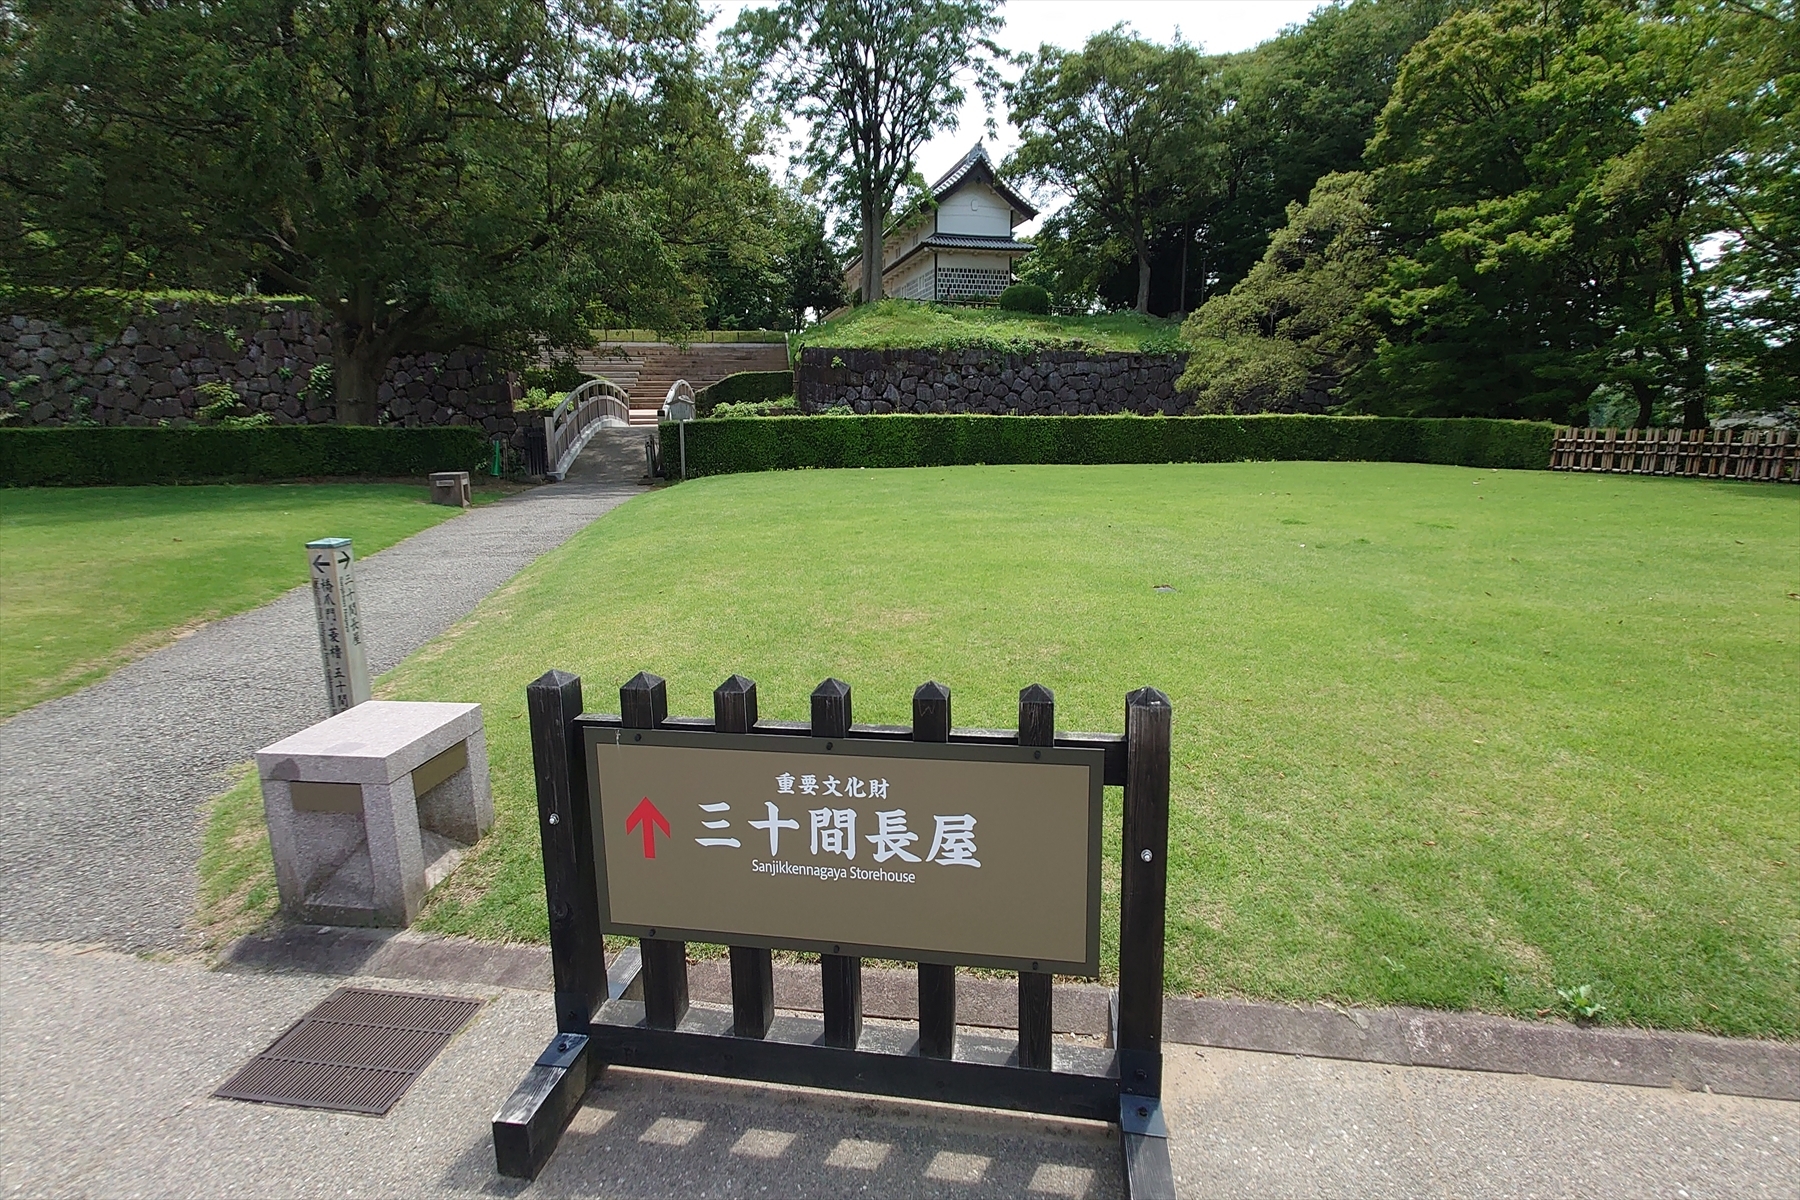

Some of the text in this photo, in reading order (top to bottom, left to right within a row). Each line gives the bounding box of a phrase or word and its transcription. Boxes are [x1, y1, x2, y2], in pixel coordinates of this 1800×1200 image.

[320, 577, 349, 710] 橋爪門・菱櫓・五十間
[774, 771, 890, 800] 重要文化財
[694, 800, 982, 868] 三十間長屋
[751, 859, 916, 884] Sanjikkennagaya Storehouse
